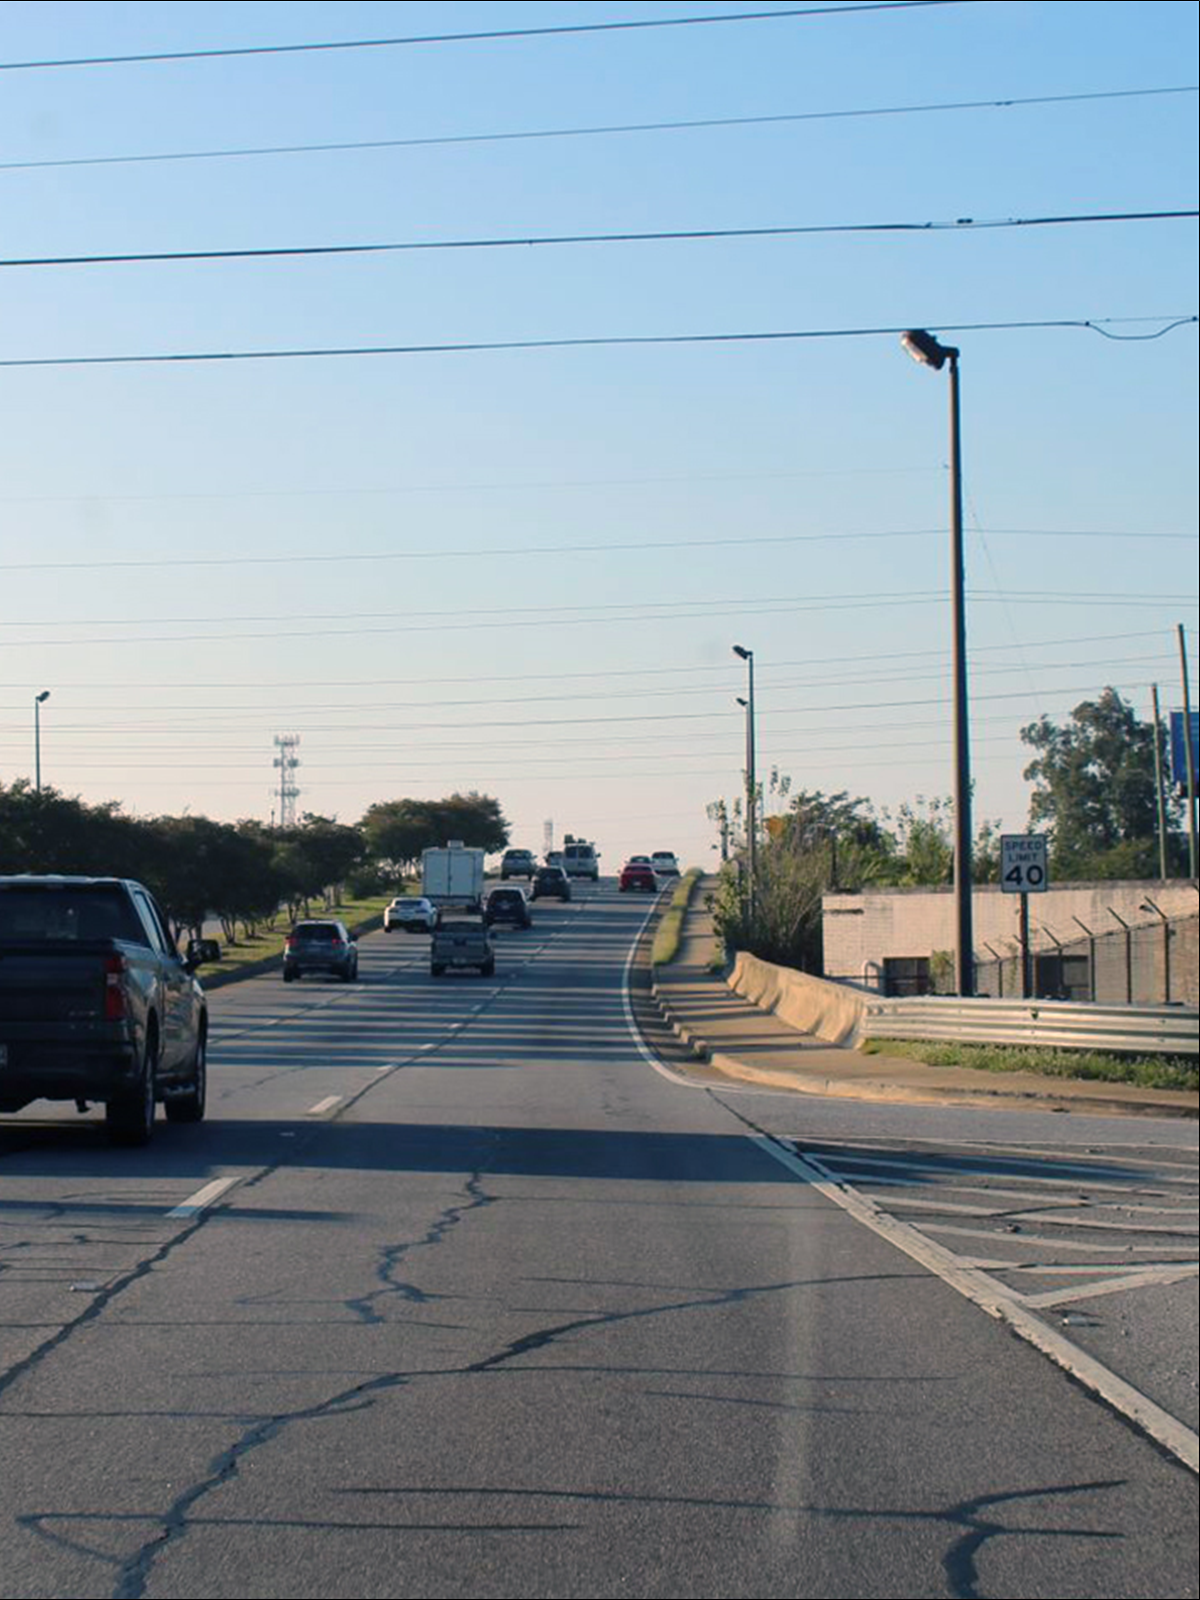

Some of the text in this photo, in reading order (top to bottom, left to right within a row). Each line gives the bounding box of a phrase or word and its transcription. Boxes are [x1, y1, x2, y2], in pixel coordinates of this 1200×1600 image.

[1005, 841, 1042, 851] SPEED
[1008, 853, 1038, 862] LIMIT
[1005, 865, 1043, 886] 40
